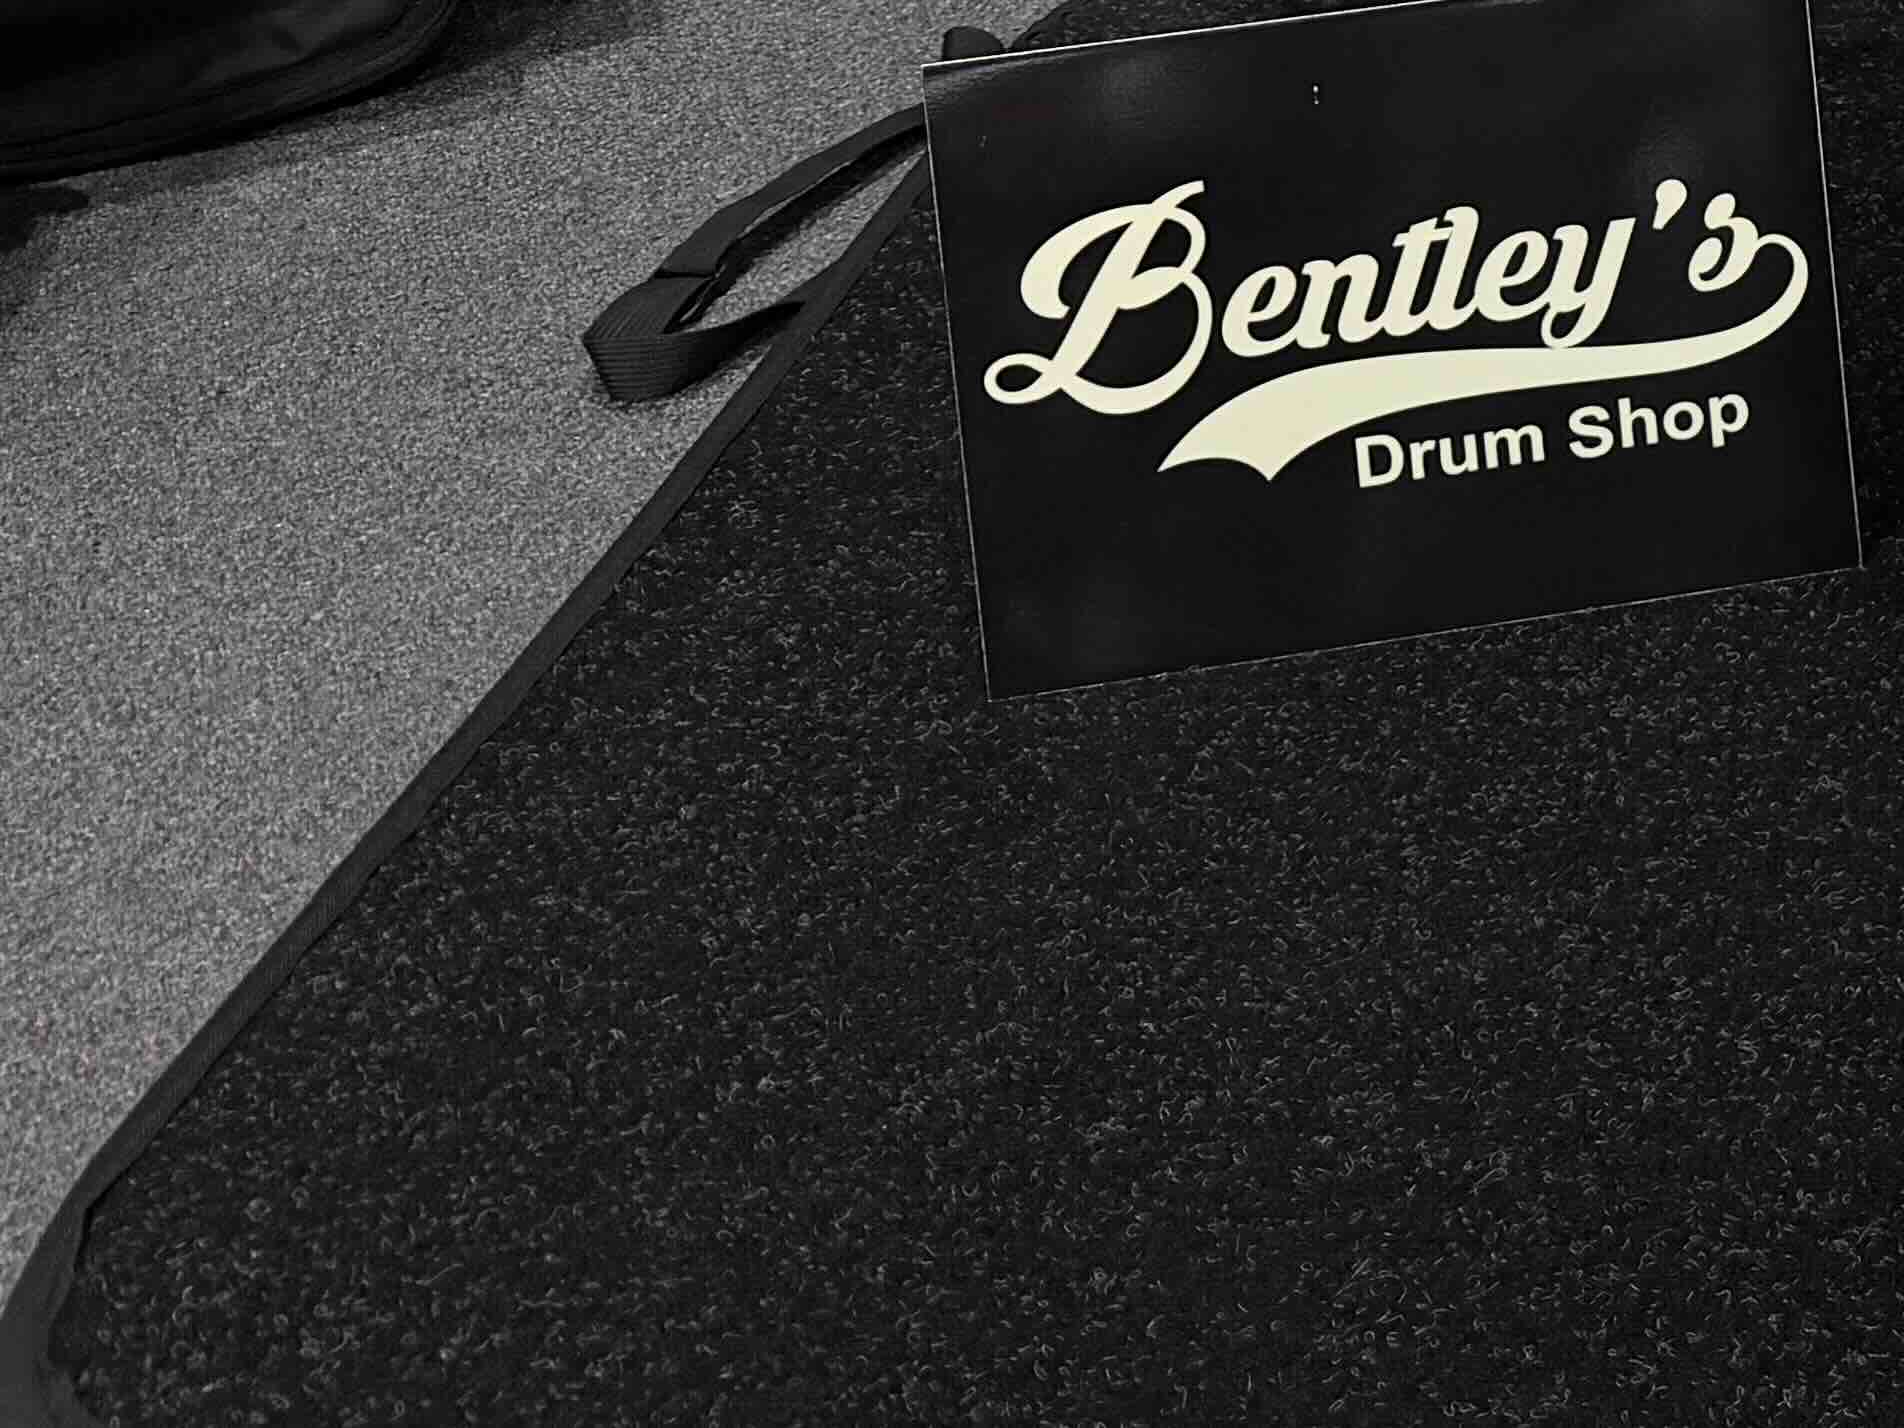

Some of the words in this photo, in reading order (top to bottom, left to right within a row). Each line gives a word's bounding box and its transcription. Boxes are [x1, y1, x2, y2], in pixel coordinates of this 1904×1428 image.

[983, 177, 1810, 415] Bentley's
[1353, 423, 1547, 489] Drum
[1567, 390, 1752, 460] Shop
